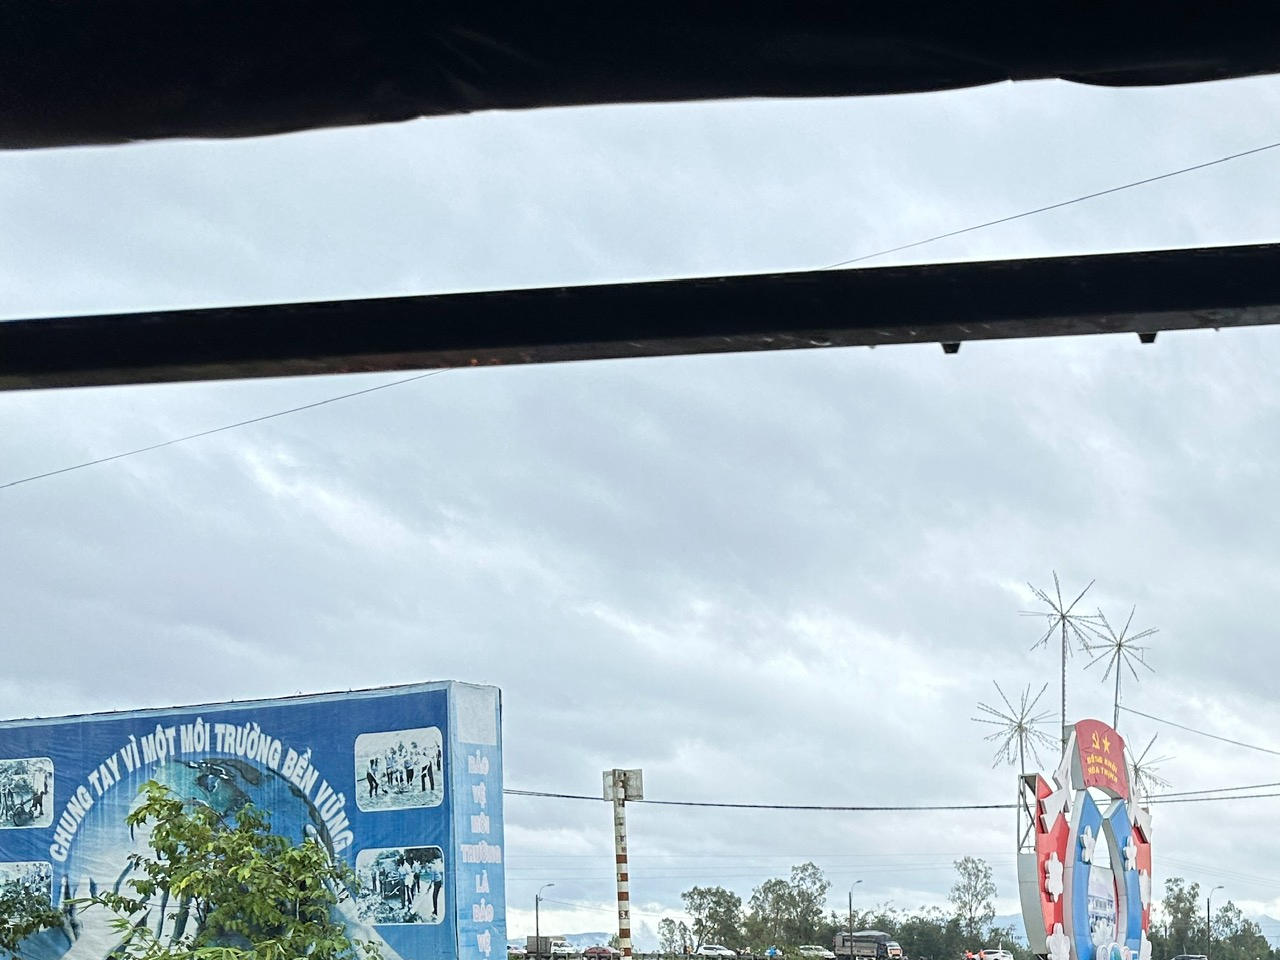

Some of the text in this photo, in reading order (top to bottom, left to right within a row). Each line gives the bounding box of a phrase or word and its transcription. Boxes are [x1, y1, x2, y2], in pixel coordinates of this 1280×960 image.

[50, 717, 354, 862] CHUNG TAY VÌ MỘT MÔI TRƯỜNG BỀN VỮNG
